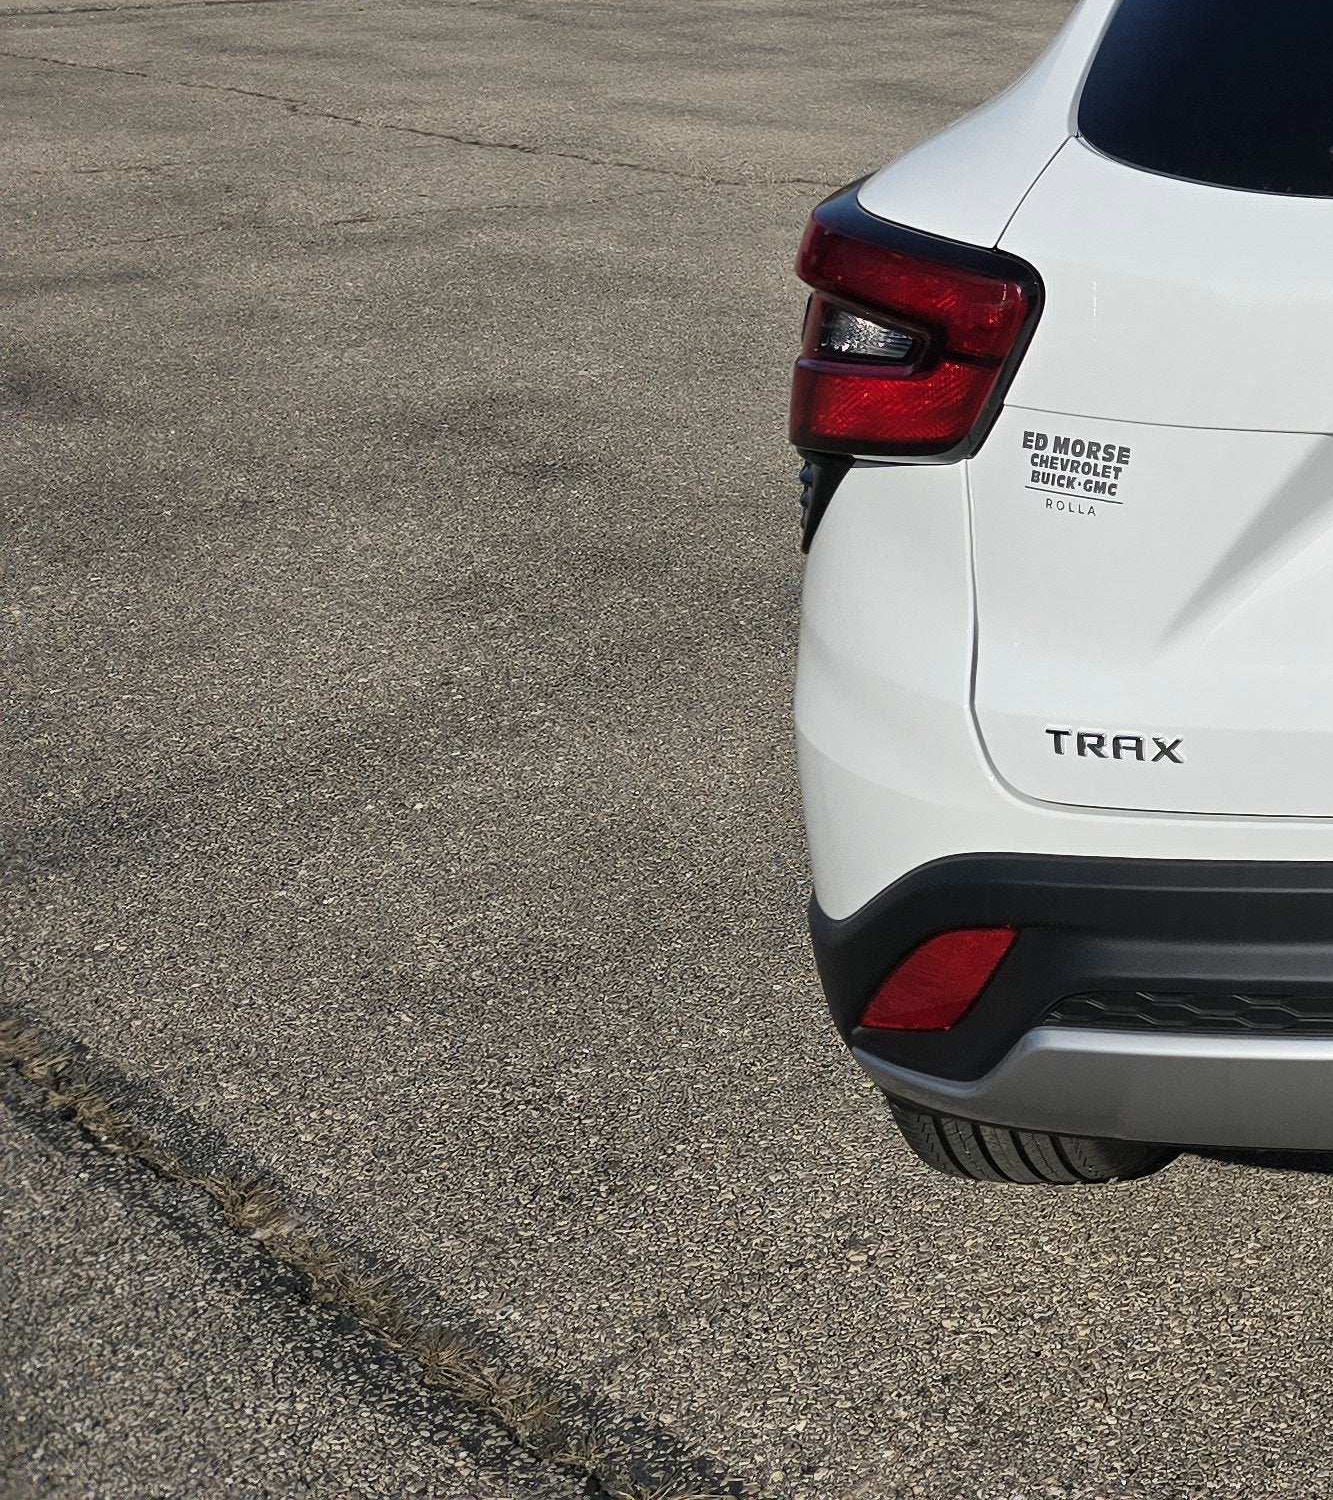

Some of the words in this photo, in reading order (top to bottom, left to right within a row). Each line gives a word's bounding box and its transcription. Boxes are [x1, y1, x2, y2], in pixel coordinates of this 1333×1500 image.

[1021, 430, 1049, 451] ED
[1052, 435, 1131, 465] MORSE
[1030, 453, 1123, 480] CHEVROLET
[1045, 498, 1097, 517] ROLLA
[1045, 728, 1185, 764] TRAX
